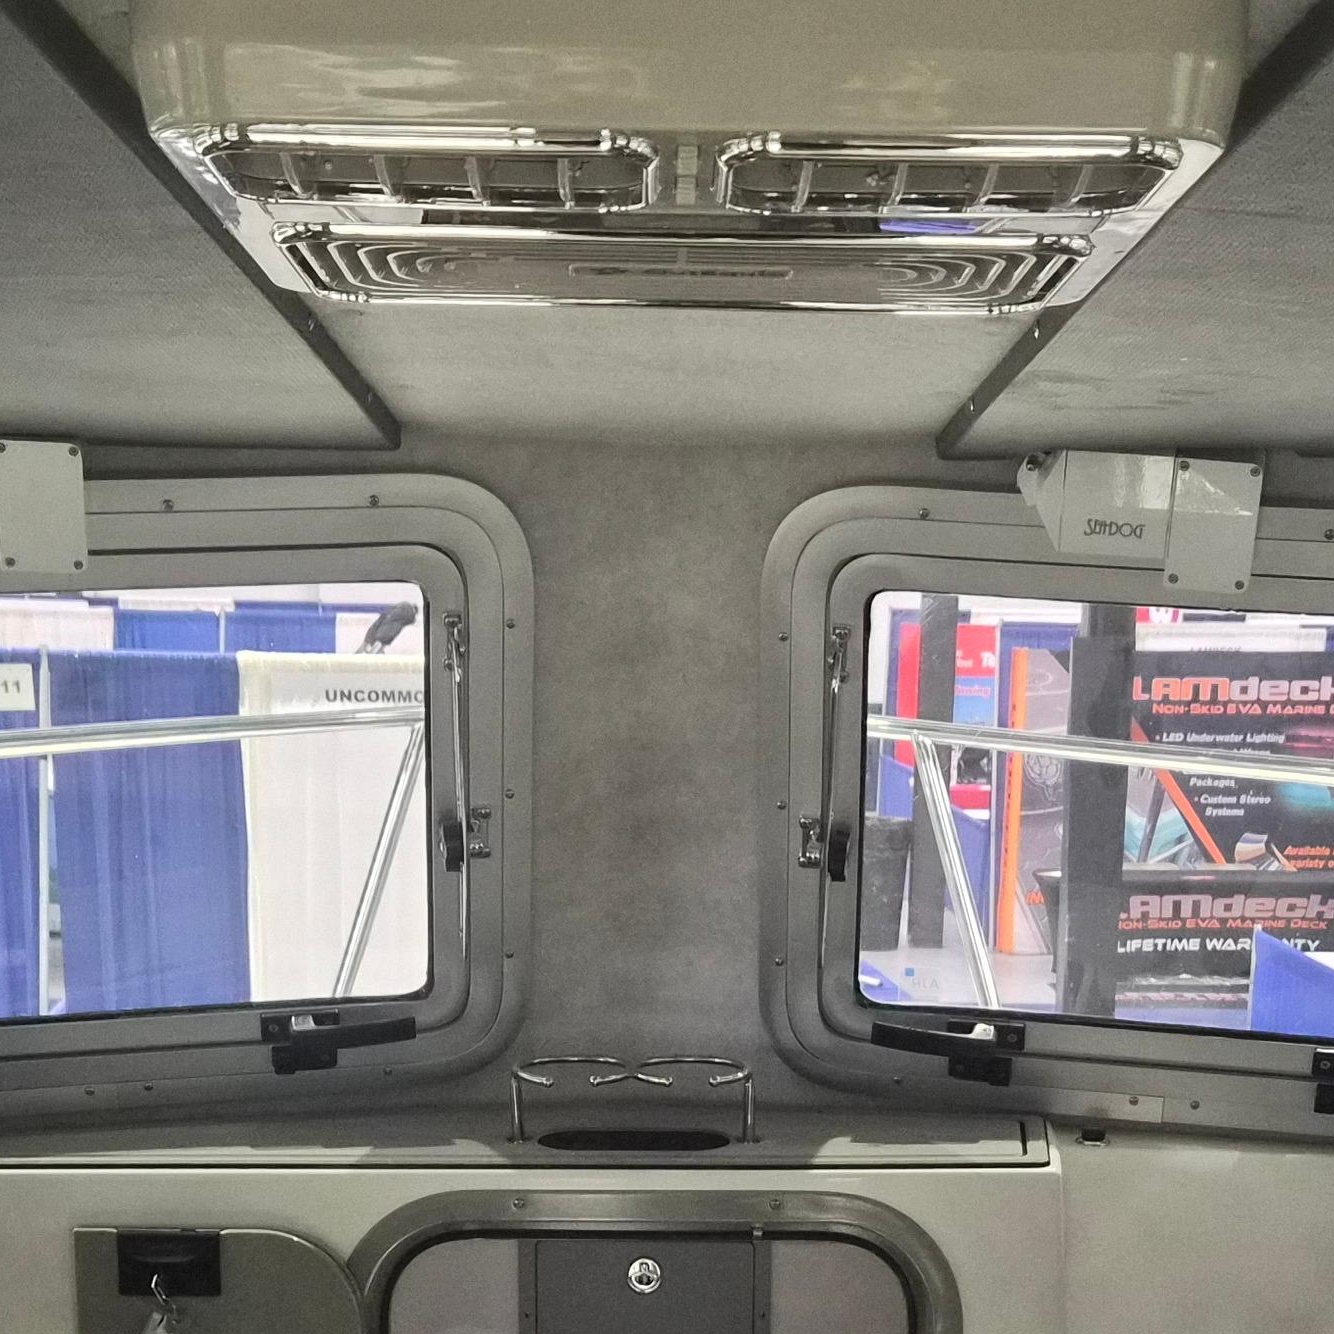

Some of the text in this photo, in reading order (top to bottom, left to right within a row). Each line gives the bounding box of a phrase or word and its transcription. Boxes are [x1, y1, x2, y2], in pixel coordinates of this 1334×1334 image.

[0, 680, 22, 694] 11
[1162, 732, 1285, 744] LED Underwater Lighting
[1117, 938, 1201, 953] LIFETIME
